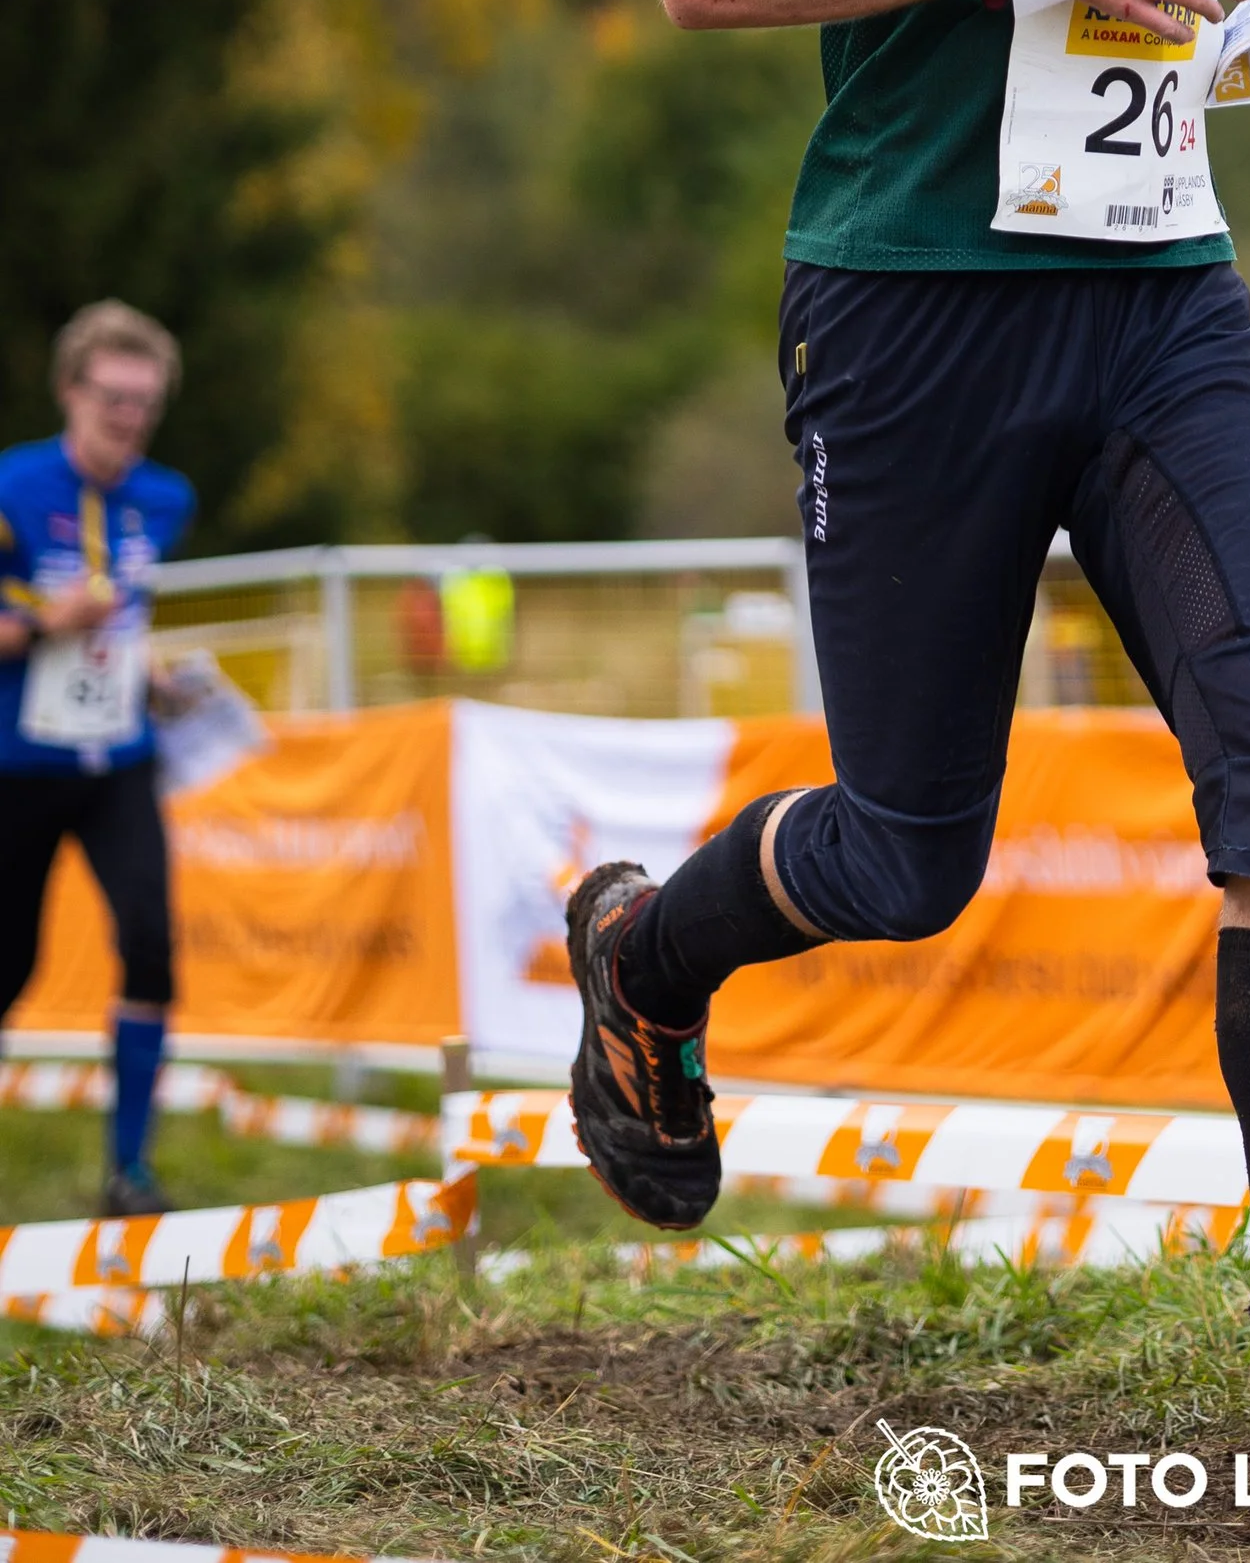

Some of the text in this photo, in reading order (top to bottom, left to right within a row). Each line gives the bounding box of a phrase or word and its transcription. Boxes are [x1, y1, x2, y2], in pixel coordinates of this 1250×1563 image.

[1081, 29, 1090, 40] A
[1093, 28, 1140, 43] LOXAM
[1085, 66, 1179, 158] 26
[1179, 118, 1196, 152] 24
